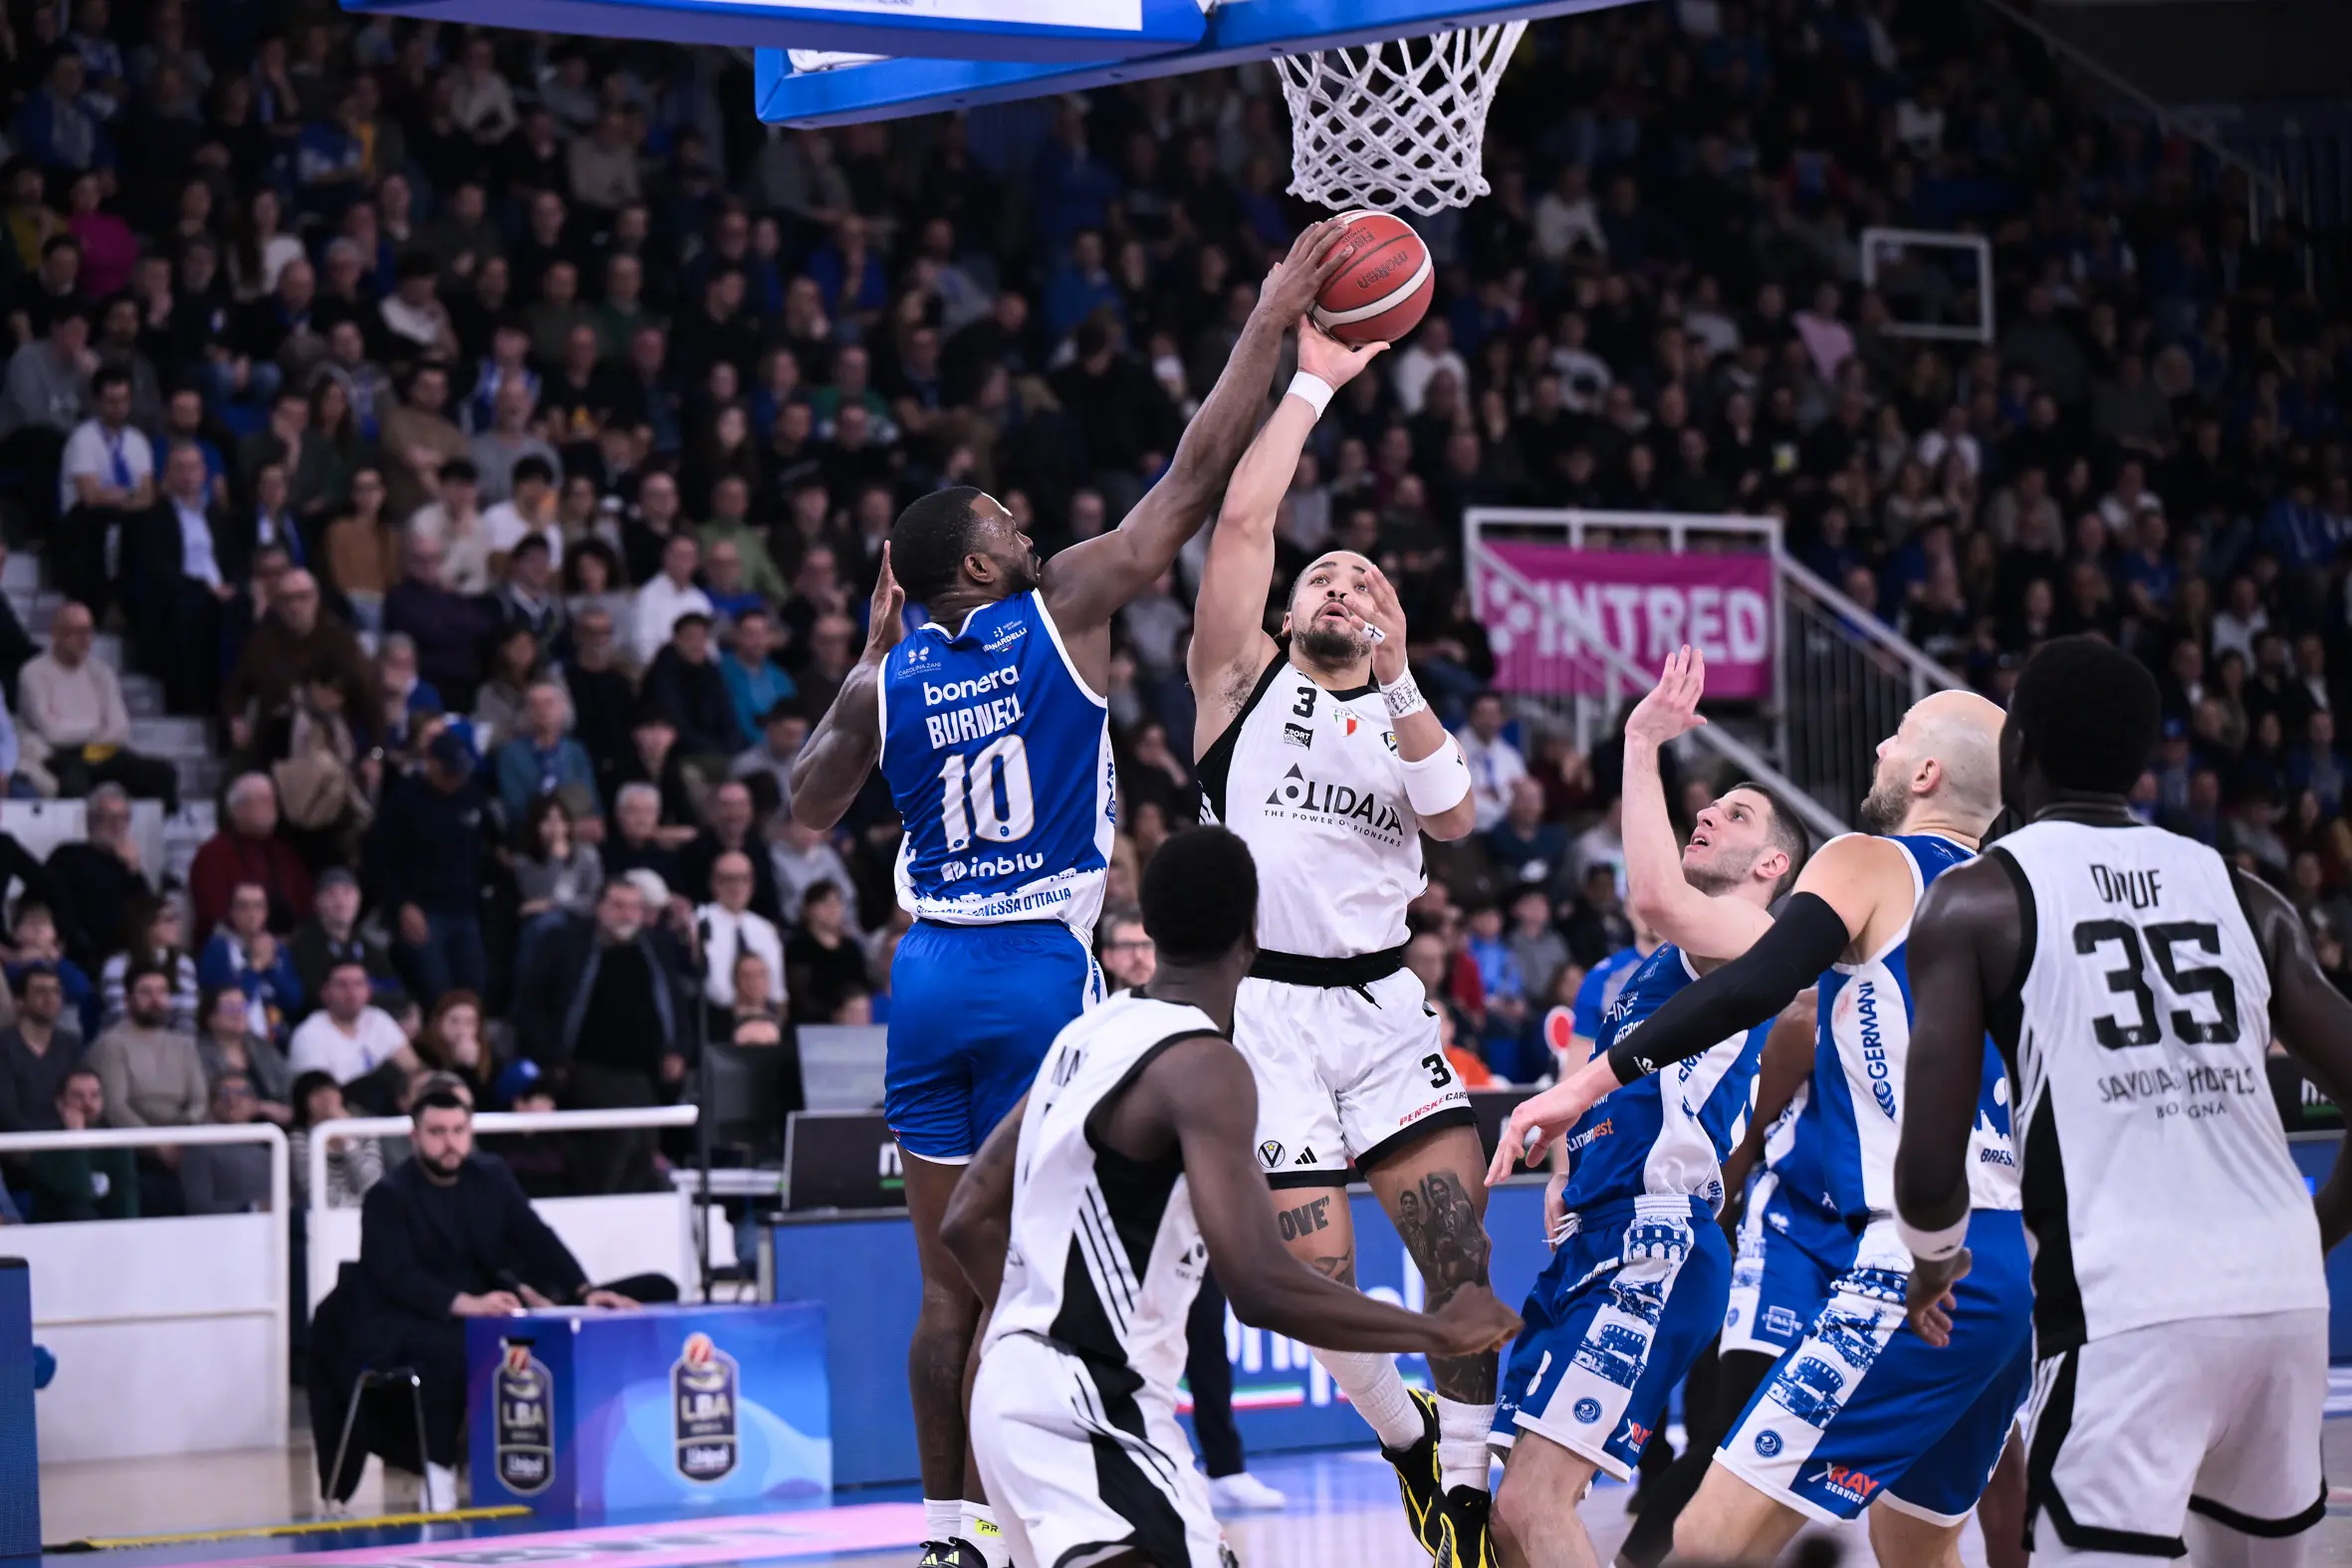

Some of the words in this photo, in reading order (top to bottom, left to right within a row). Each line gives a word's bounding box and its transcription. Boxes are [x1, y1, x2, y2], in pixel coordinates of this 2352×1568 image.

[1350, 232, 1375, 250] FIB
[1355, 251, 1408, 290] molten
[1535, 580, 1768, 663] INTRED
[923, 664, 1020, 706] bonera
[1293, 686, 1317, 719] 3
[925, 692, 1025, 750] BURNELL
[1285, 728, 1310, 740] SPORT
[938, 734, 1035, 853] 10
[1293, 812, 1333, 825] POWER
[1353, 824, 1401, 847] PIONEERS
[970, 851, 1044, 878] inblu
[1024, 887, 1071, 911] D'ITALIA
[2072, 918, 2241, 1051] 35
[1857, 981, 1888, 1080] GERMANI
[1421, 1052, 1452, 1089] 3
[2097, 1066, 2174, 1103] SAVOIA
[2156, 1102, 2227, 1119] BOGNA
[1980, 1148, 2015, 1167] BRES
[1278, 1195, 1330, 1241] OVE”
[502, 1401, 546, 1428] LBA
[680, 1393, 731, 1423] LBA
[1806, 1460, 1880, 1497] XRAY
[1824, 1480, 1866, 1505] SERVICE
[981, 1524, 1001, 1533] PR
